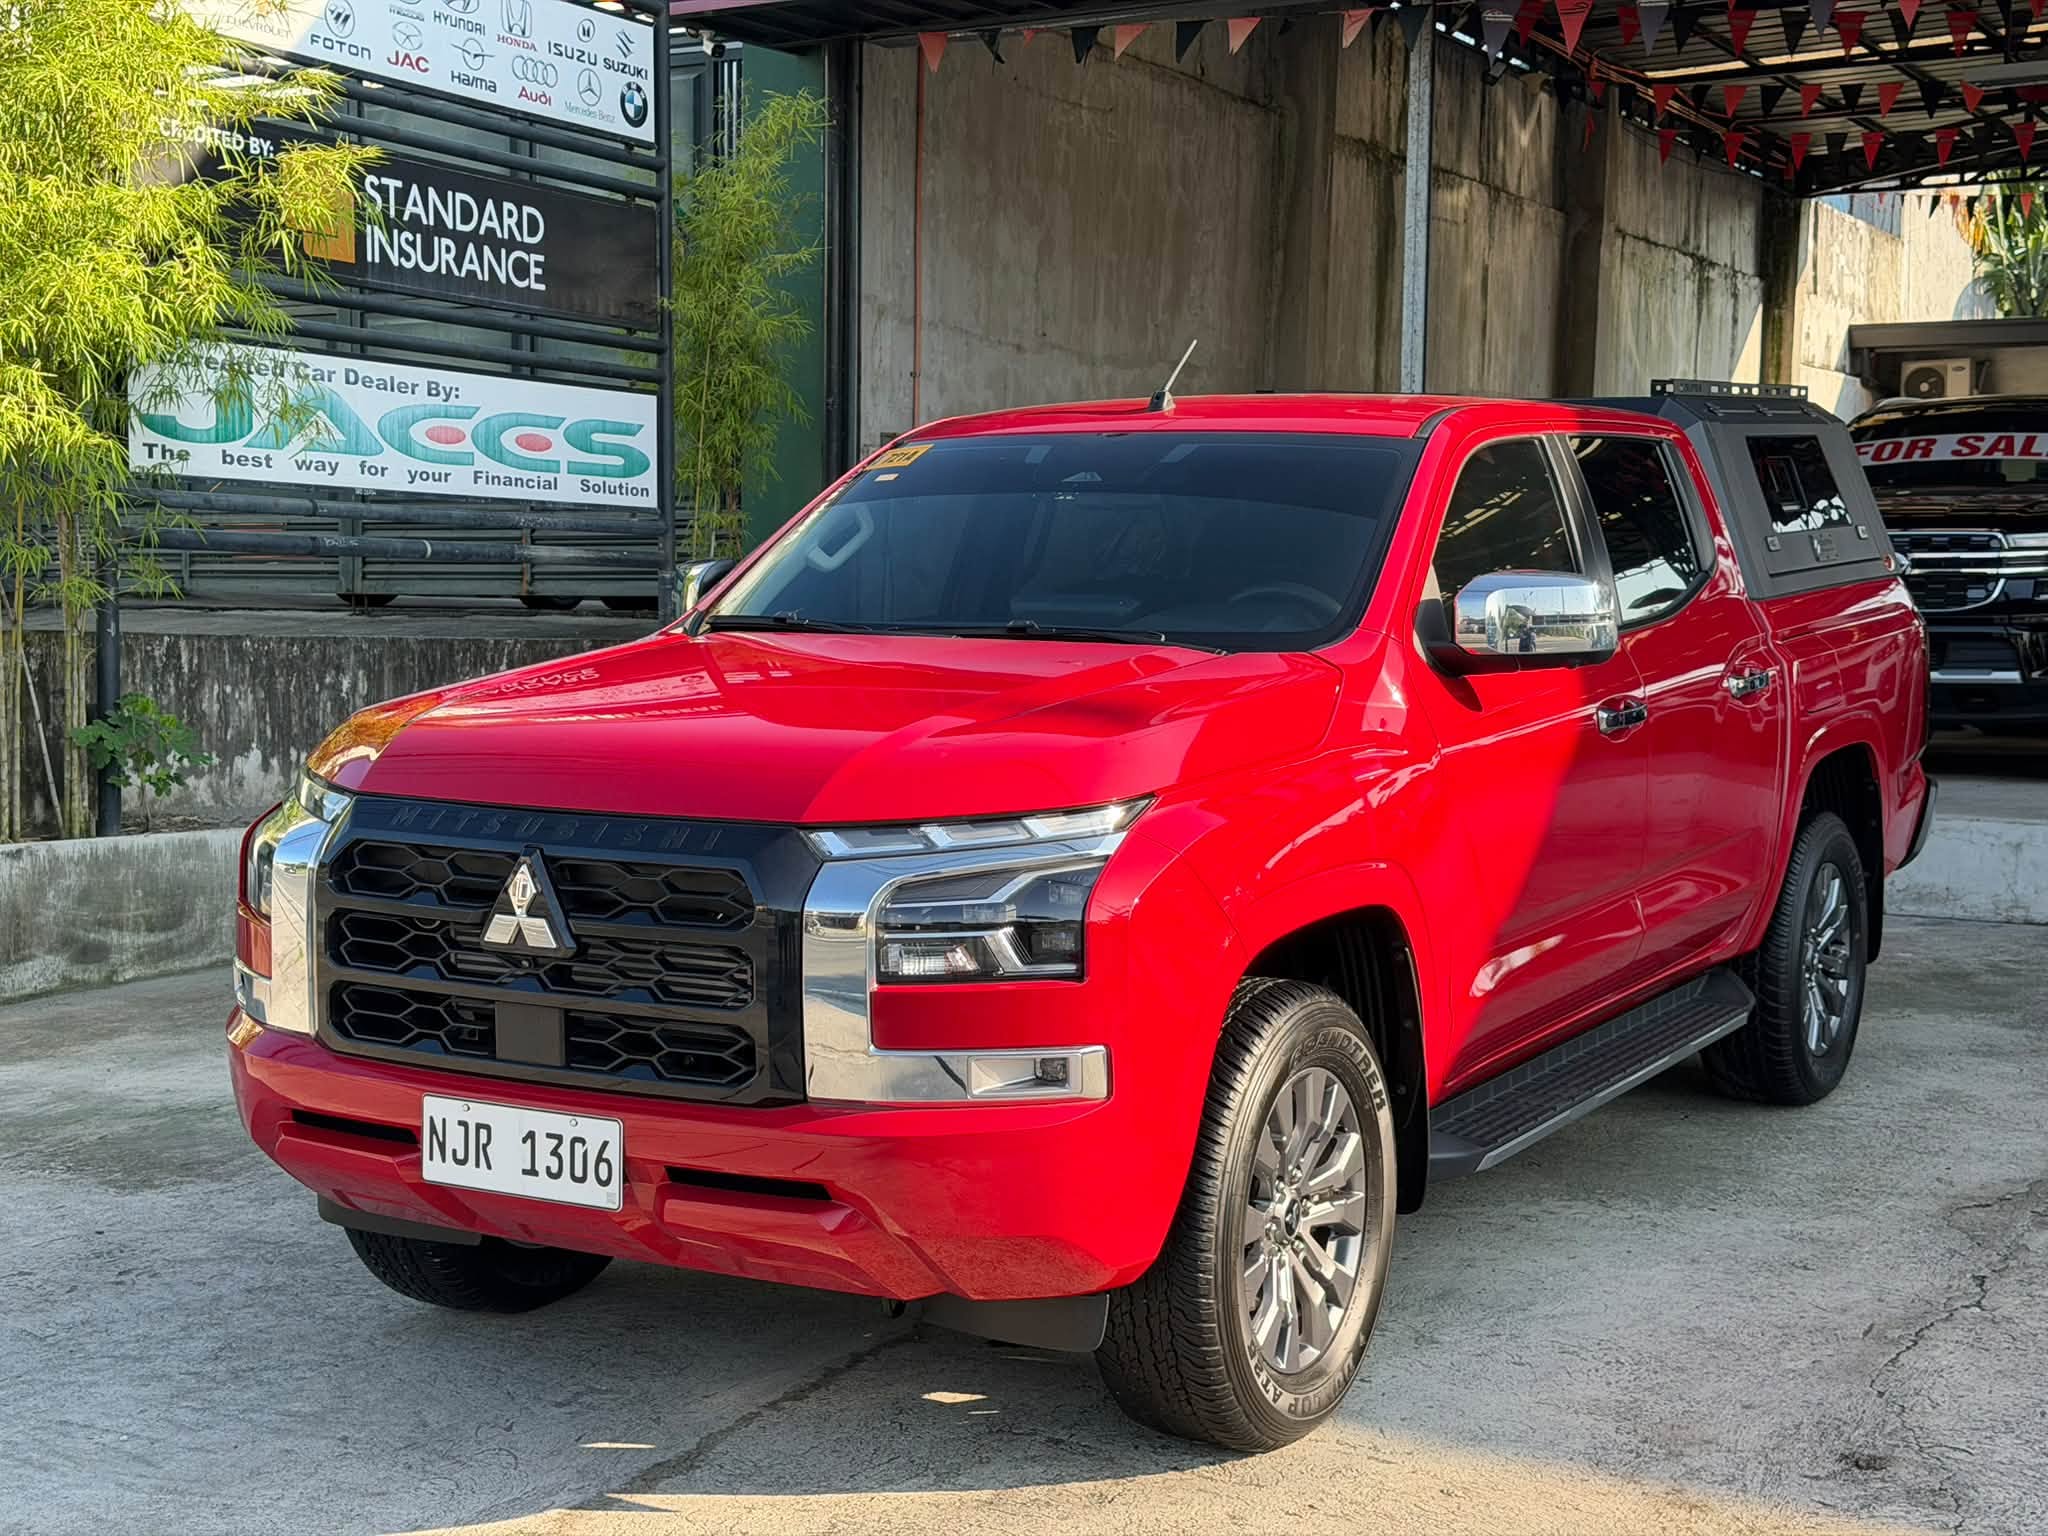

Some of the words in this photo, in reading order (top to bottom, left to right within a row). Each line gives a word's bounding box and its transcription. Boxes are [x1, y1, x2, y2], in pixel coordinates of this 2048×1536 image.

[433, 11, 486, 36] HYUNDAI
[310, 34, 372, 60] FOTON
[496, 34, 537, 51] HONDA
[548, 40, 598, 66] ISUZU
[387, 50, 430, 73] JAC
[603, 57, 648, 80] SUZUKI
[518, 86, 552, 106] Audi
[249, 136, 275, 158] BY:
[364, 174, 545, 244] STANDARD
[366, 223, 546, 291] INSURANCE
[294, 361, 336, 383] Car
[344, 367, 419, 395] Dealer
[427, 380, 460, 402] By:
[140, 380, 651, 479] JACCS
[1855, 438, 1938, 462] FOR
[1951, 435, 2048, 457] SAL
[142, 442, 192, 461] The
[221, 449, 273, 469] best
[294, 459, 340, 476] way
[359, 460, 389, 477] for
[407, 469, 452, 484] your
[473, 470, 558, 490] Financial
[580, 479, 650, 497] Solution
[390, 806, 723, 851] MITSUBISHI
[429, 1115, 492, 1170] NJR
[521, 1130, 613, 1188] 1306
